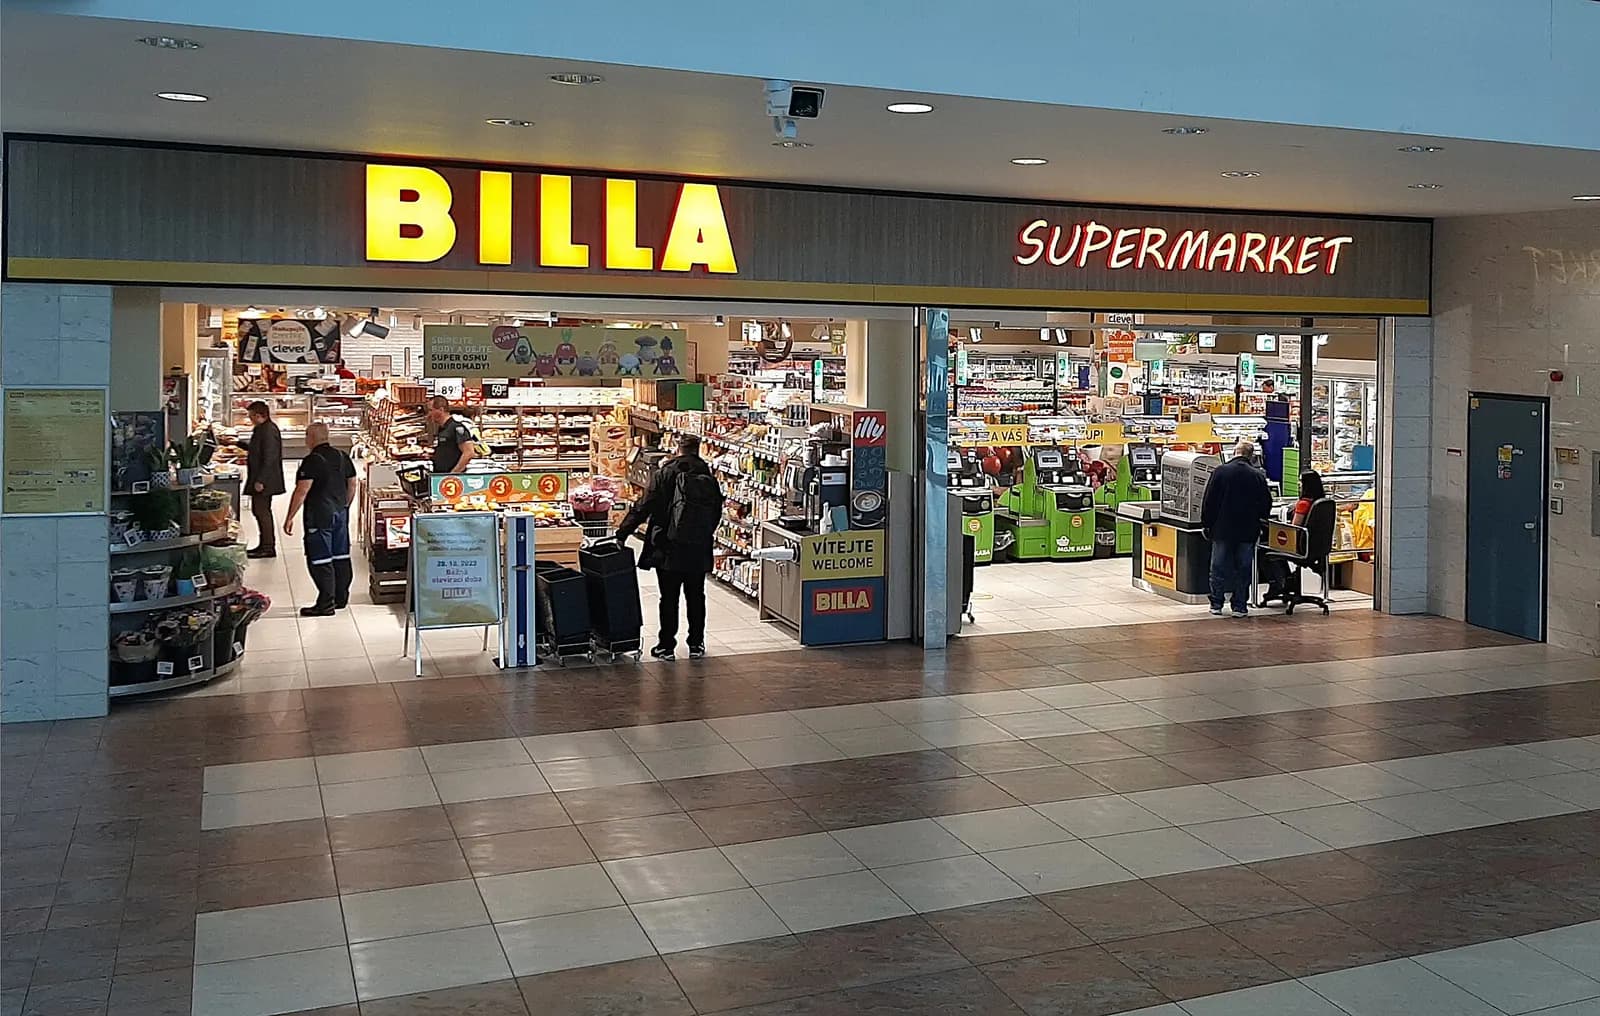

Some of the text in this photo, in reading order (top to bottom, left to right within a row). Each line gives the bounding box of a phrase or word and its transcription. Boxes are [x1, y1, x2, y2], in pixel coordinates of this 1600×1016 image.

[364, 163, 738, 274] BILLA
[1014, 219, 1353, 275] SUPERMARKET
[1108, 314, 1133, 324] cleve
[272, 345, 306, 353] clever
[431, 354, 461, 362] SUPER
[854, 415, 885, 443] illy
[1001, 428, 1023, 441] VÁŠ
[446, 482, 457, 496] 3
[495, 481, 506, 494] 3
[544, 479, 554, 493] 3
[812, 537, 874, 555] VÍTEJTE
[812, 556, 874, 571] WELCOME
[1146, 554, 1172, 576] BILLA
[815, 590, 870, 611] BILLA
